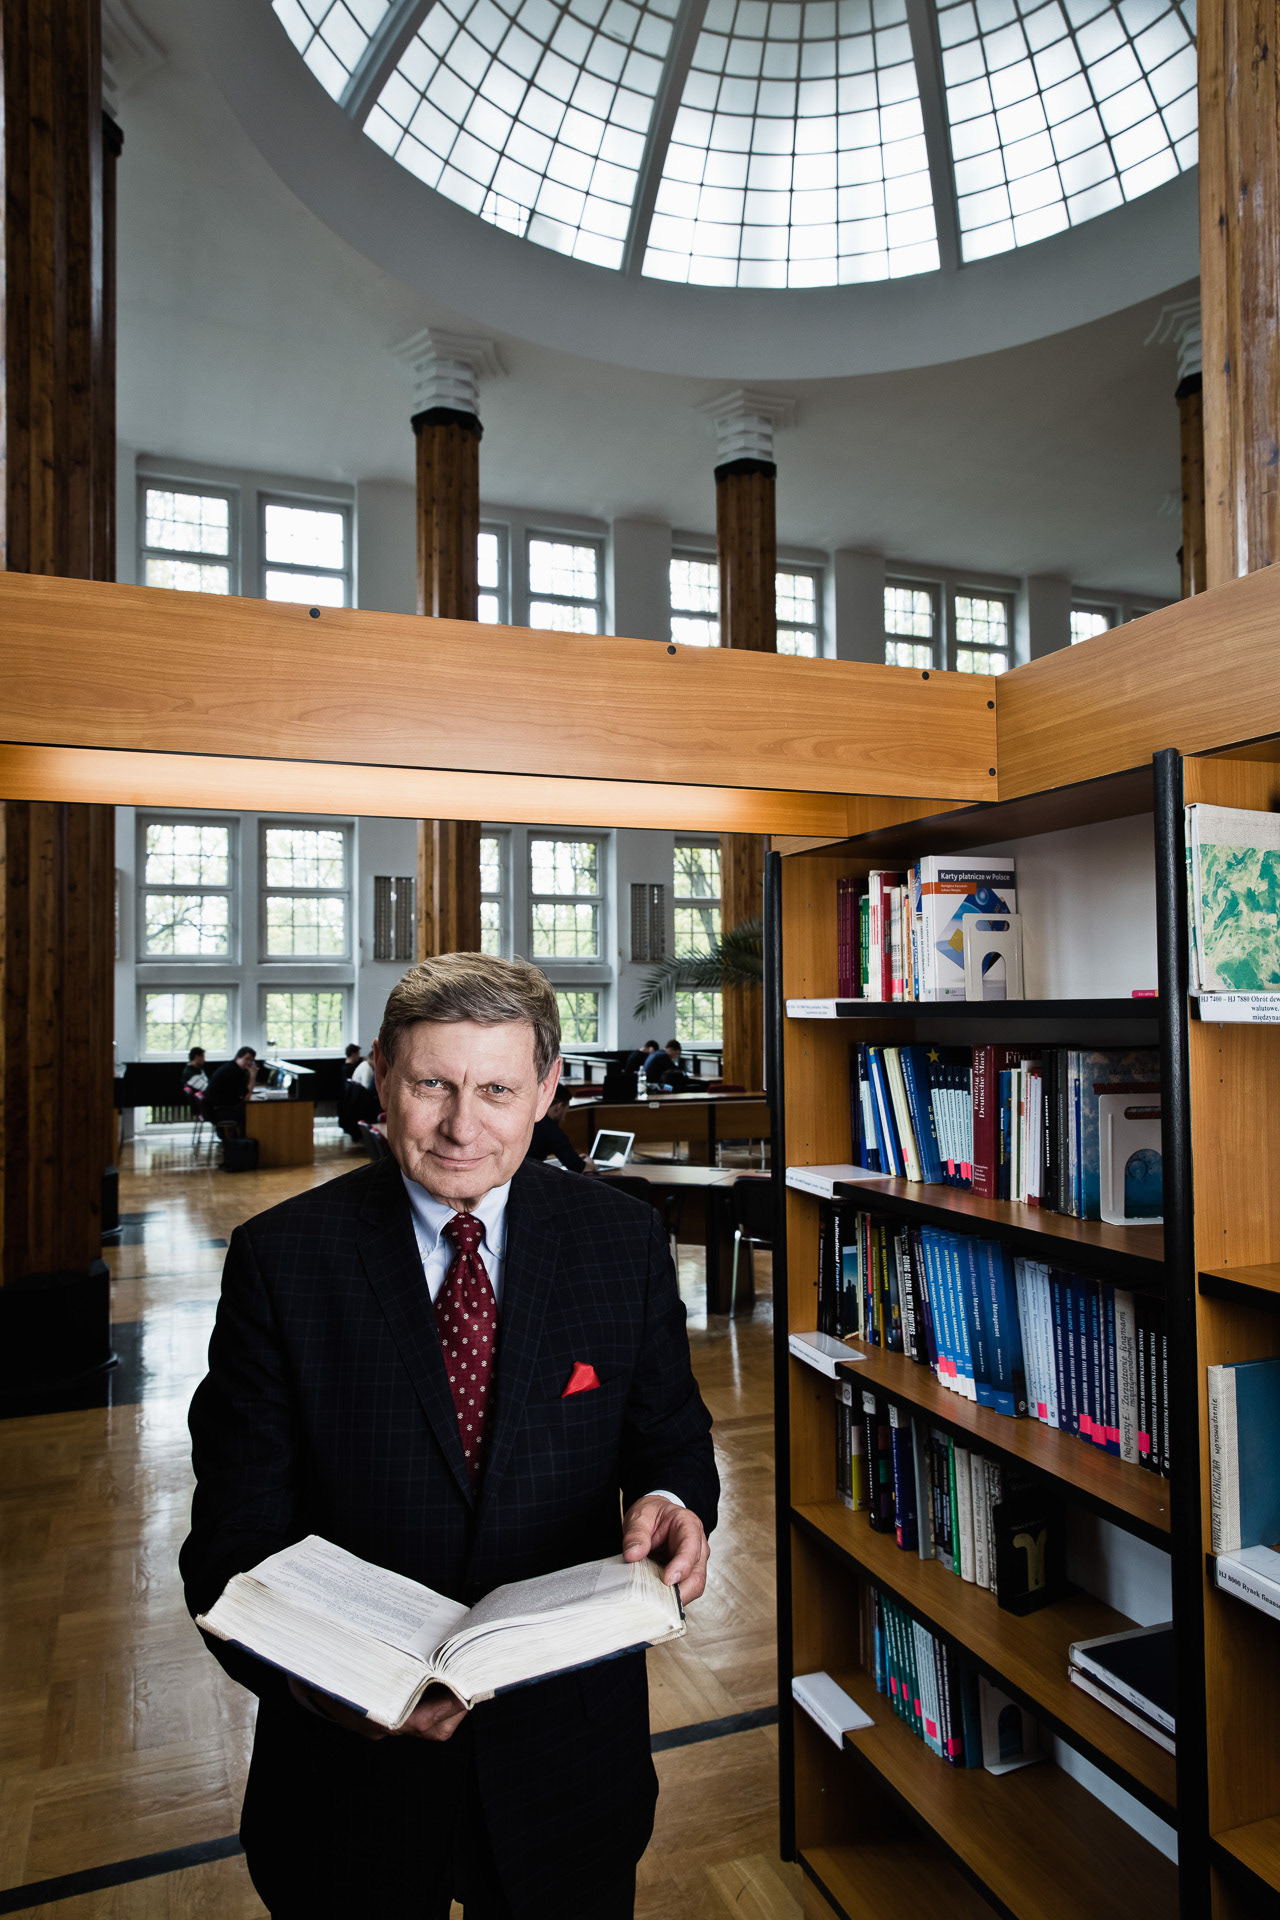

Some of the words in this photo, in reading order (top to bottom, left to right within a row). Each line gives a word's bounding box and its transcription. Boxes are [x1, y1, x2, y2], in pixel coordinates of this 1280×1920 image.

[940, 872, 958, 882] Karty
[958, 872, 986, 882] płatnicze
[902, 1254, 911, 1272] GOING
[925, 1244, 935, 1282] INTERNATIONAL
[934, 1247, 944, 1285] INTERNATIONAL
[944, 1250, 954, 1290] INTERNATIONAL
[953, 1252, 963, 1292] INTERNATIONAL
[904, 1272, 913, 1293] GLOBAL
[930, 1283, 938, 1308] FINANCIAL
[938, 1286, 947, 1312] FINANCIAL
[905, 1294, 914, 1308] WITH
[949, 1290, 957, 1316] FINANCIAL
[958, 1292, 966, 1320] FINANCIAL
[973, 1298, 981, 1331] Management
[906, 1310, 916, 1335] EQUITIES
[933, 1309, 942, 1344] MANAGEMENT
[942, 1313, 951, 1348] MANAGEMENT
[952, 1317, 961, 1353] MANAGEMENT
[991, 1304, 1000, 1337] Management
[1119, 1311, 1129, 1352] finansami
[961, 1321, 970, 1357] MANAGEMENT
[1120, 1356, 1131, 1406] Zarządzanie
[1125, 1337, 1135, 1408] międzynarodowymi
[1122, 1422, 1133, 1459] Najlepszy
[1212, 1398, 1221, 1455] wprowadzenie
[1212, 1460, 1222, 1510] TECHNICZNA
[1212, 1513, 1222, 1549] ANALIZA
[1218, 1570, 1227, 1579] HJ
[1228, 1575, 1241, 1586] 8000
[1242, 1583, 1260, 1598] Rynek
